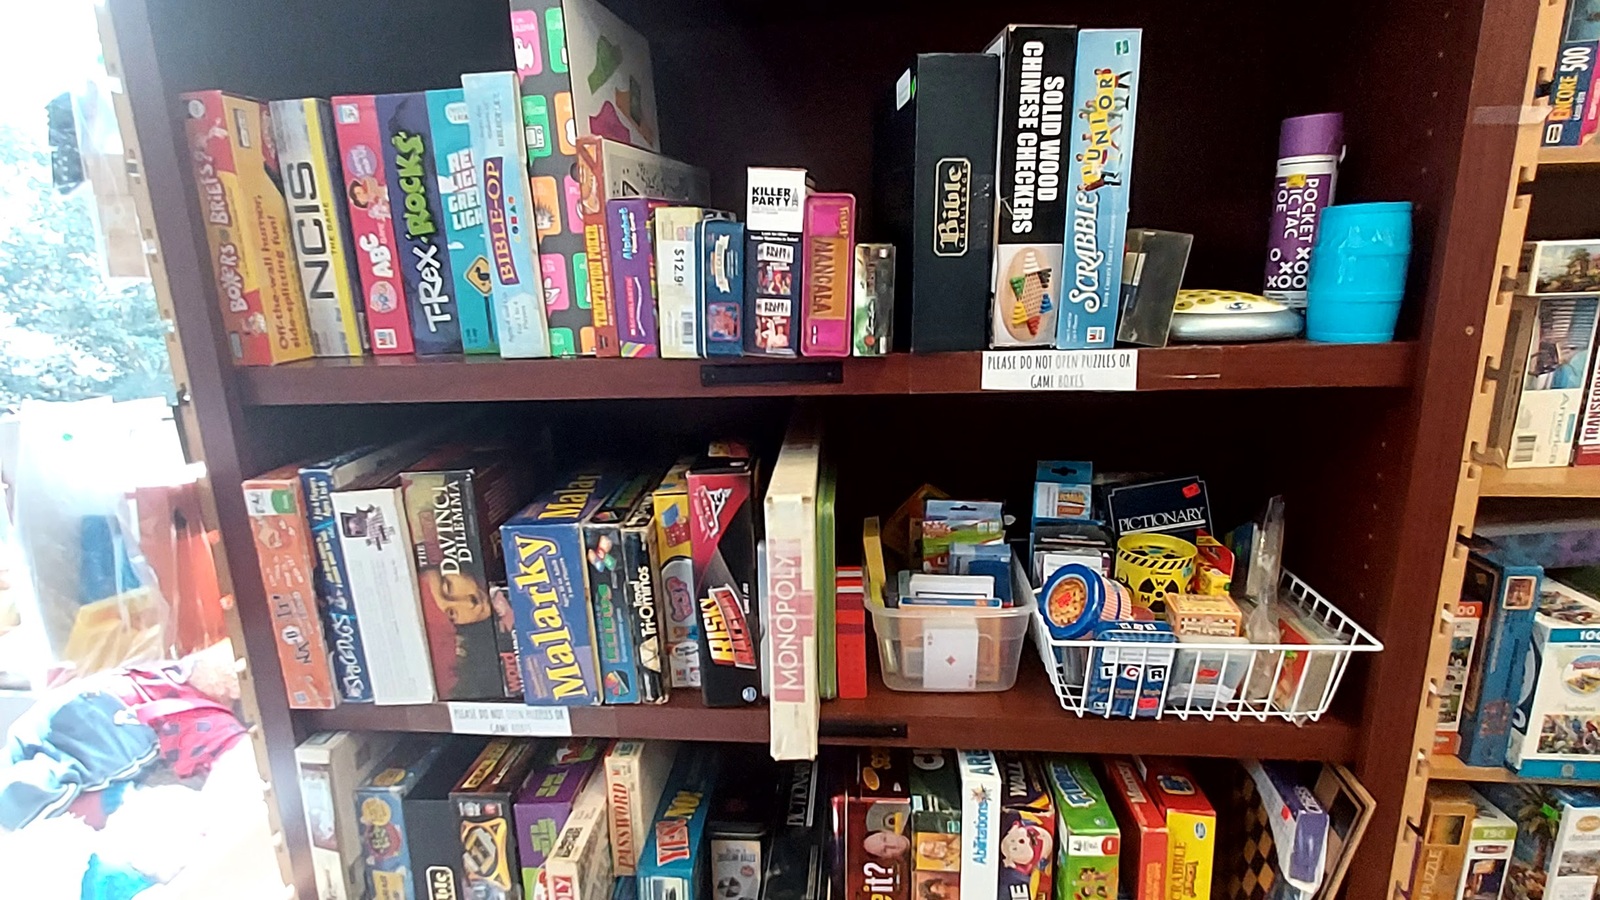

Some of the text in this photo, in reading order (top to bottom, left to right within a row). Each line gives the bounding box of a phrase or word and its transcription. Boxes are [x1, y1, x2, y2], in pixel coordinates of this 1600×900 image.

[1559, 46, 1592, 72] 500
[1011, 40, 1044, 235] CHINESE CHECKERS
[1037, 76, 1065, 202] SOLID WOOD
[392, 133, 438, 238] ROCKS
[448, 190, 481, 213] GRE
[752, 186, 791, 197] KILLER
[752, 196, 790, 207] PARTY
[937, 165, 962, 250] Bible
[1298, 178, 1319, 243] POCKET
[287, 161, 335, 300] NCIS
[323, 201, 338, 254] THE GAME
[452, 209, 484, 231] LIGH
[485, 160, 516, 282] BIBLE-OP
[585, 224, 600, 259] POKER
[617, 206, 633, 260] Alphabet
[1069, 189, 1101, 313] SCRABBLE
[1283, 208, 1301, 239] TAC
[253, 194, 289, 350] Off-the-wall humor,
[267, 214, 301, 349] side-splitting fun!
[359, 232, 394, 278] ABC
[672, 248, 685, 286] $12.9
[811, 239, 835, 314] MANCALA
[589, 262, 608, 327] TEMPTATION
[988, 353, 1131, 370] PLEASE DO NOT OPEN PUZZLES OR
[1030, 374, 1084, 389] GAME BOXES
[431, 484, 460, 576] DAVINCI
[446, 480, 474, 563] DILEMMA
[1118, 507, 1205, 531] PICTIONARY
[416, 544, 428, 567] THE
[513, 535, 589, 700] Malarky
[629, 581, 643, 608] Travel
[636, 565, 657, 638] Tri-Ominos
[775, 553, 799, 690] MONOPOLY
[698, 596, 735, 661] RISKY
[719, 589, 754, 664] RACEWAY
[1151, 670, 1162, 680] R
[613, 782, 635, 869] PASSWORD
[863, 861, 894, 893] it?
[1169, 841, 1186, 900] CRABBLE
[1420, 849, 1443, 895] PUZZLE
